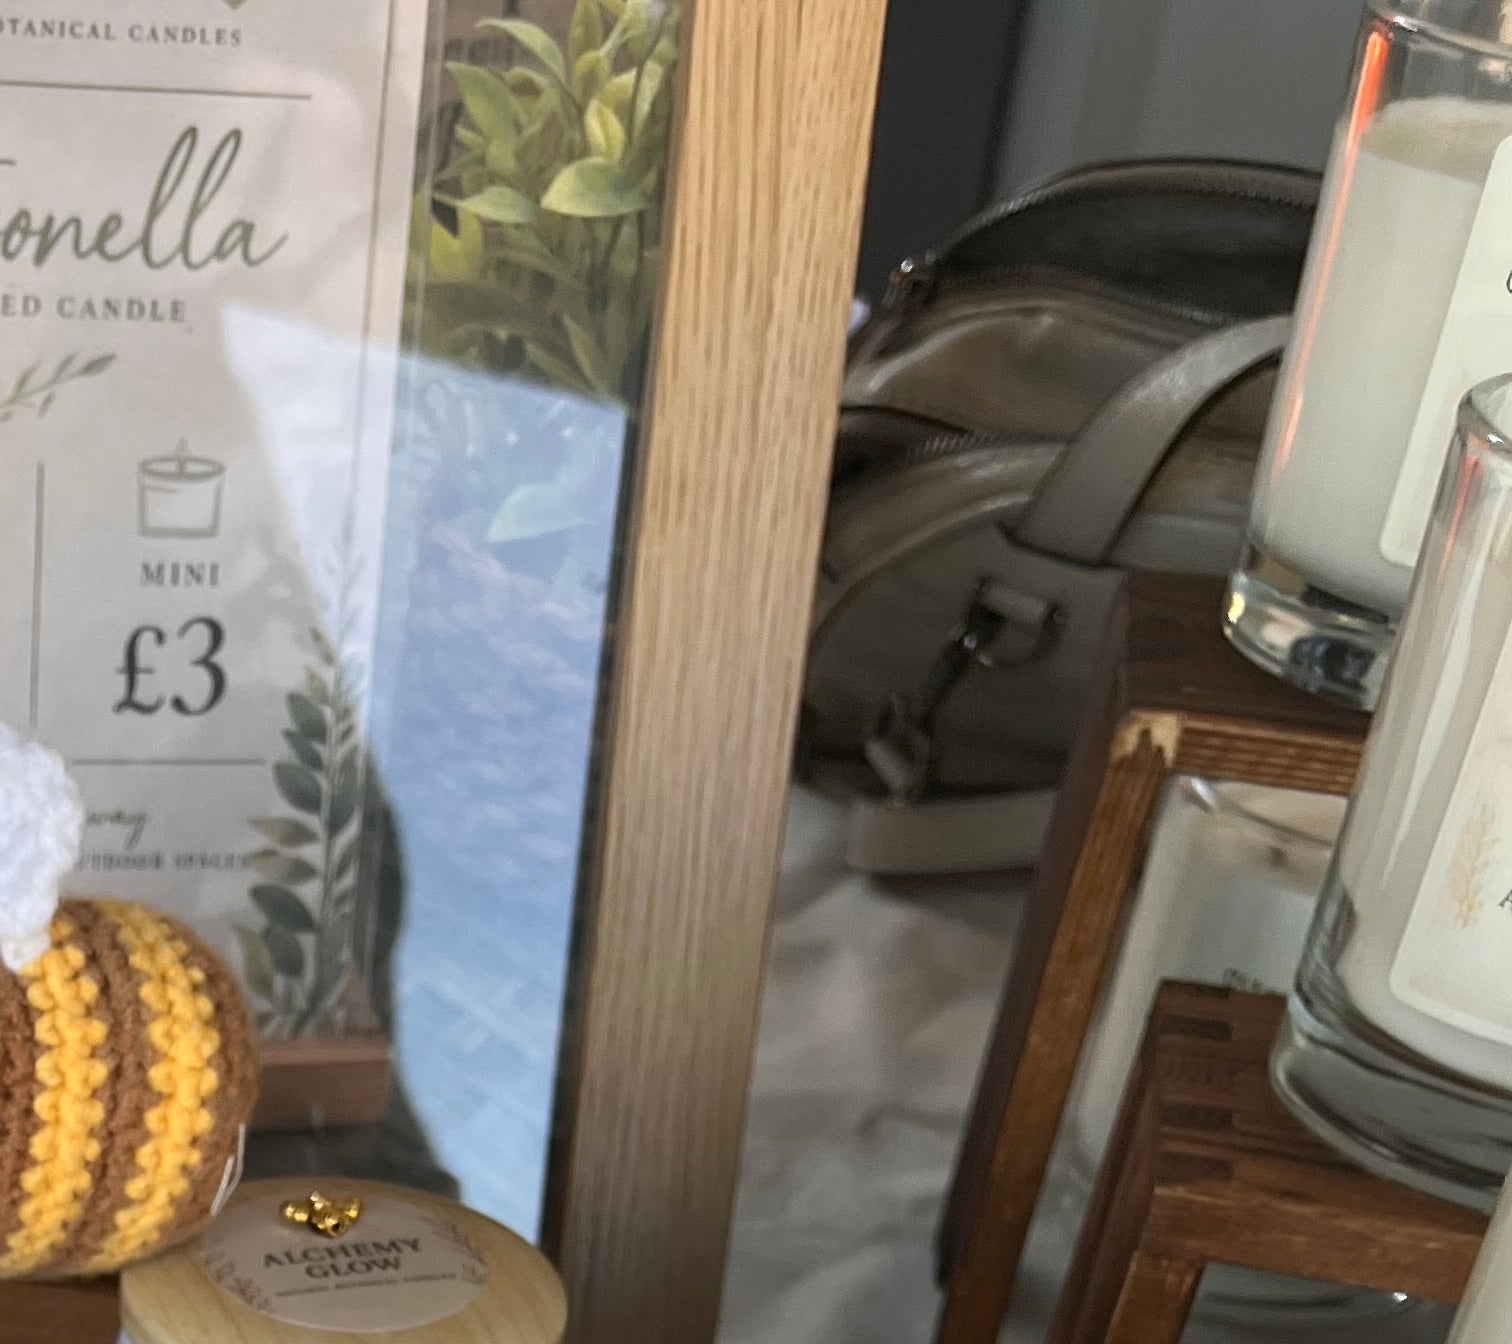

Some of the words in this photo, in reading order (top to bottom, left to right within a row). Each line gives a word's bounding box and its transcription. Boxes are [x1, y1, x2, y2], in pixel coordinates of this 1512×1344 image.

[127, 24, 242, 47] CANDLES
[56, 297, 187, 324] CANDLE
[141, 562, 221, 587] MINI
[114, 616, 228, 715] £3
[264, 1237, 420, 1268] ALCHEMY
[306, 1256, 401, 1280] GLOW
